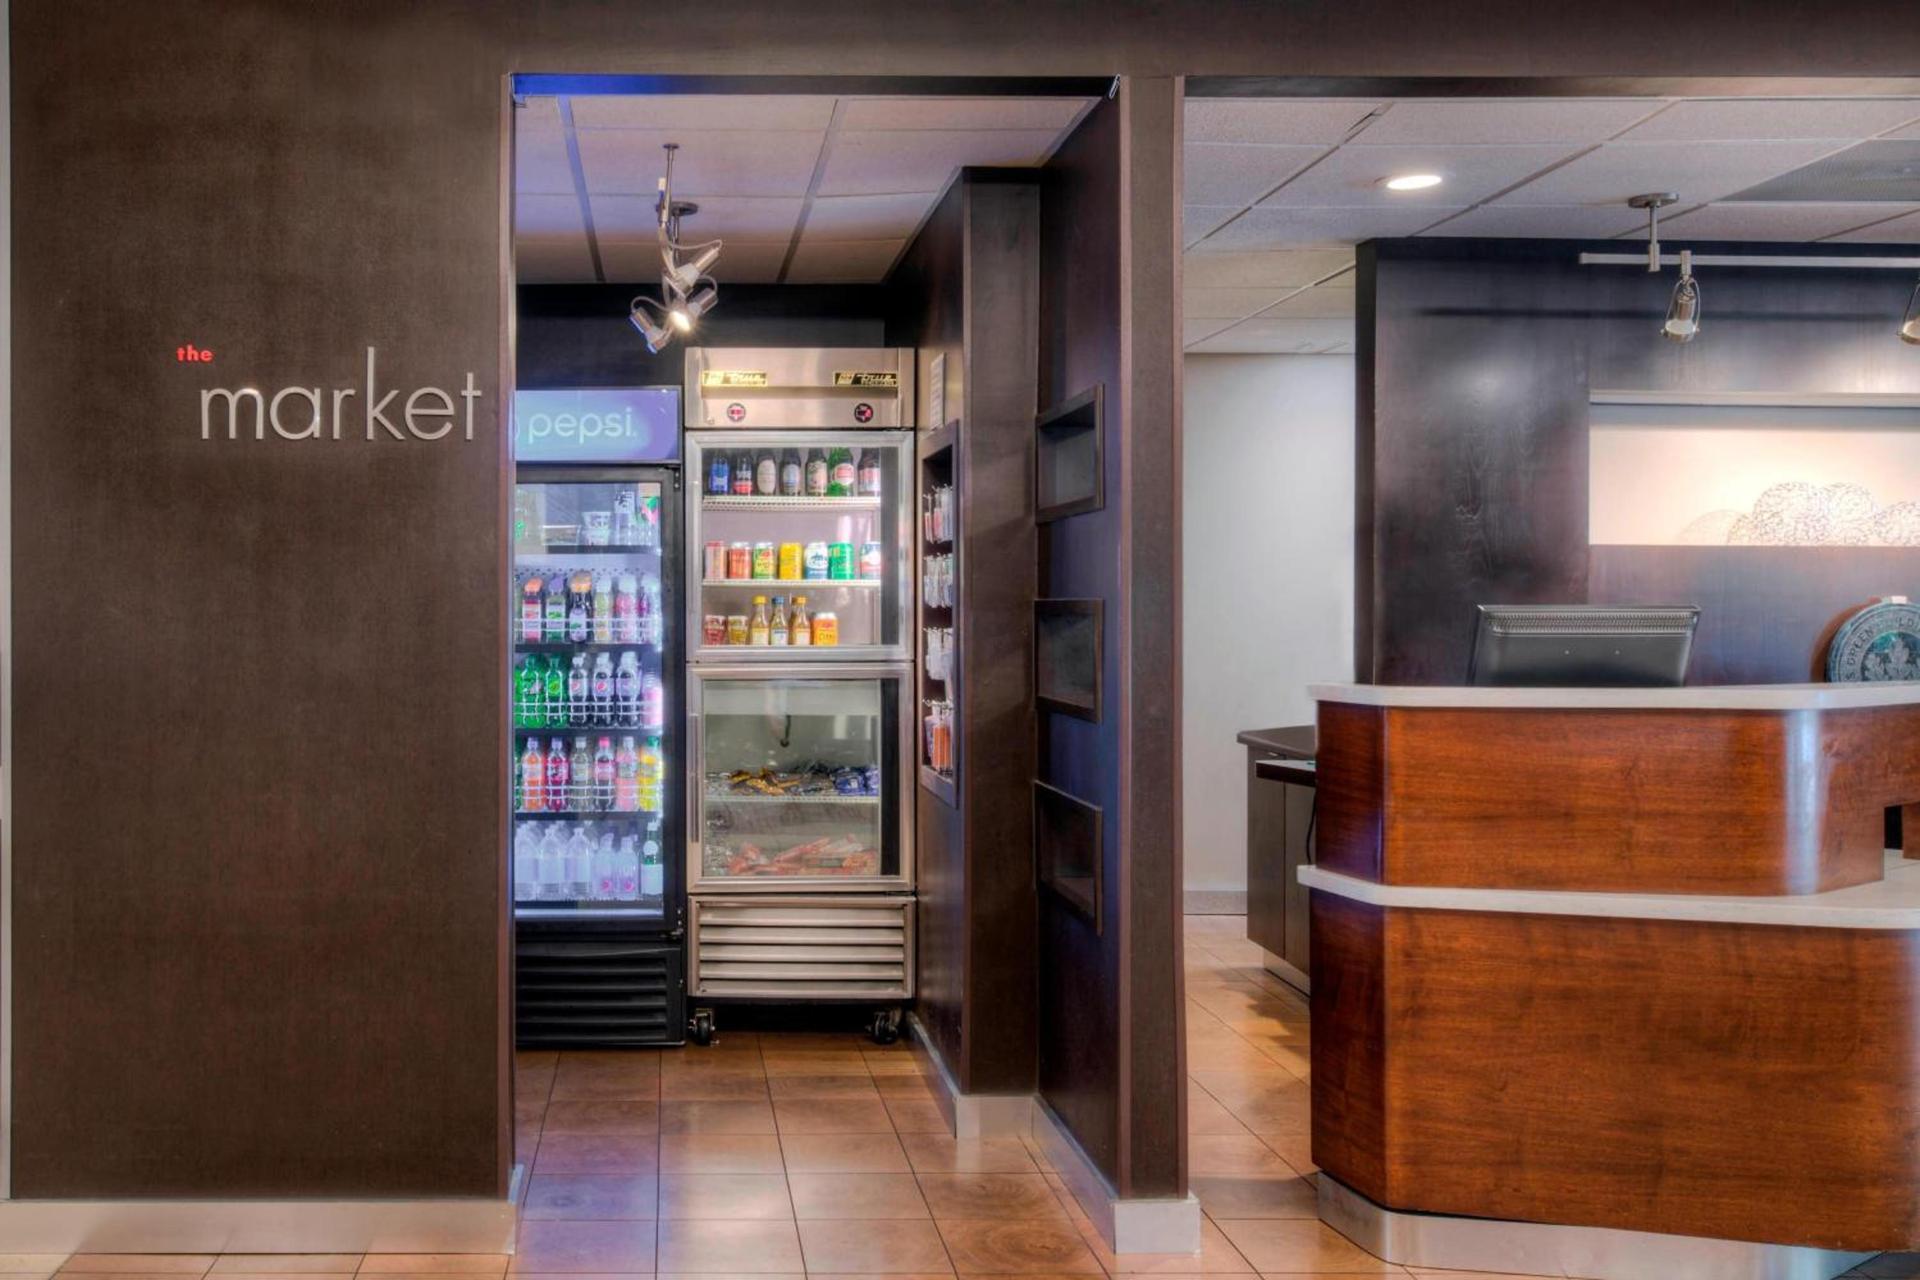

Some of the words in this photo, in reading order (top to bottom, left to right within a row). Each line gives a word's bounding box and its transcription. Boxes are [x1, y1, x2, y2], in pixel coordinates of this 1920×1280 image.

[176, 344, 213, 362] the
[201, 346, 482, 440] market
[528, 406, 633, 445] pepsi
[1846, 625, 1875, 666] GREEN
